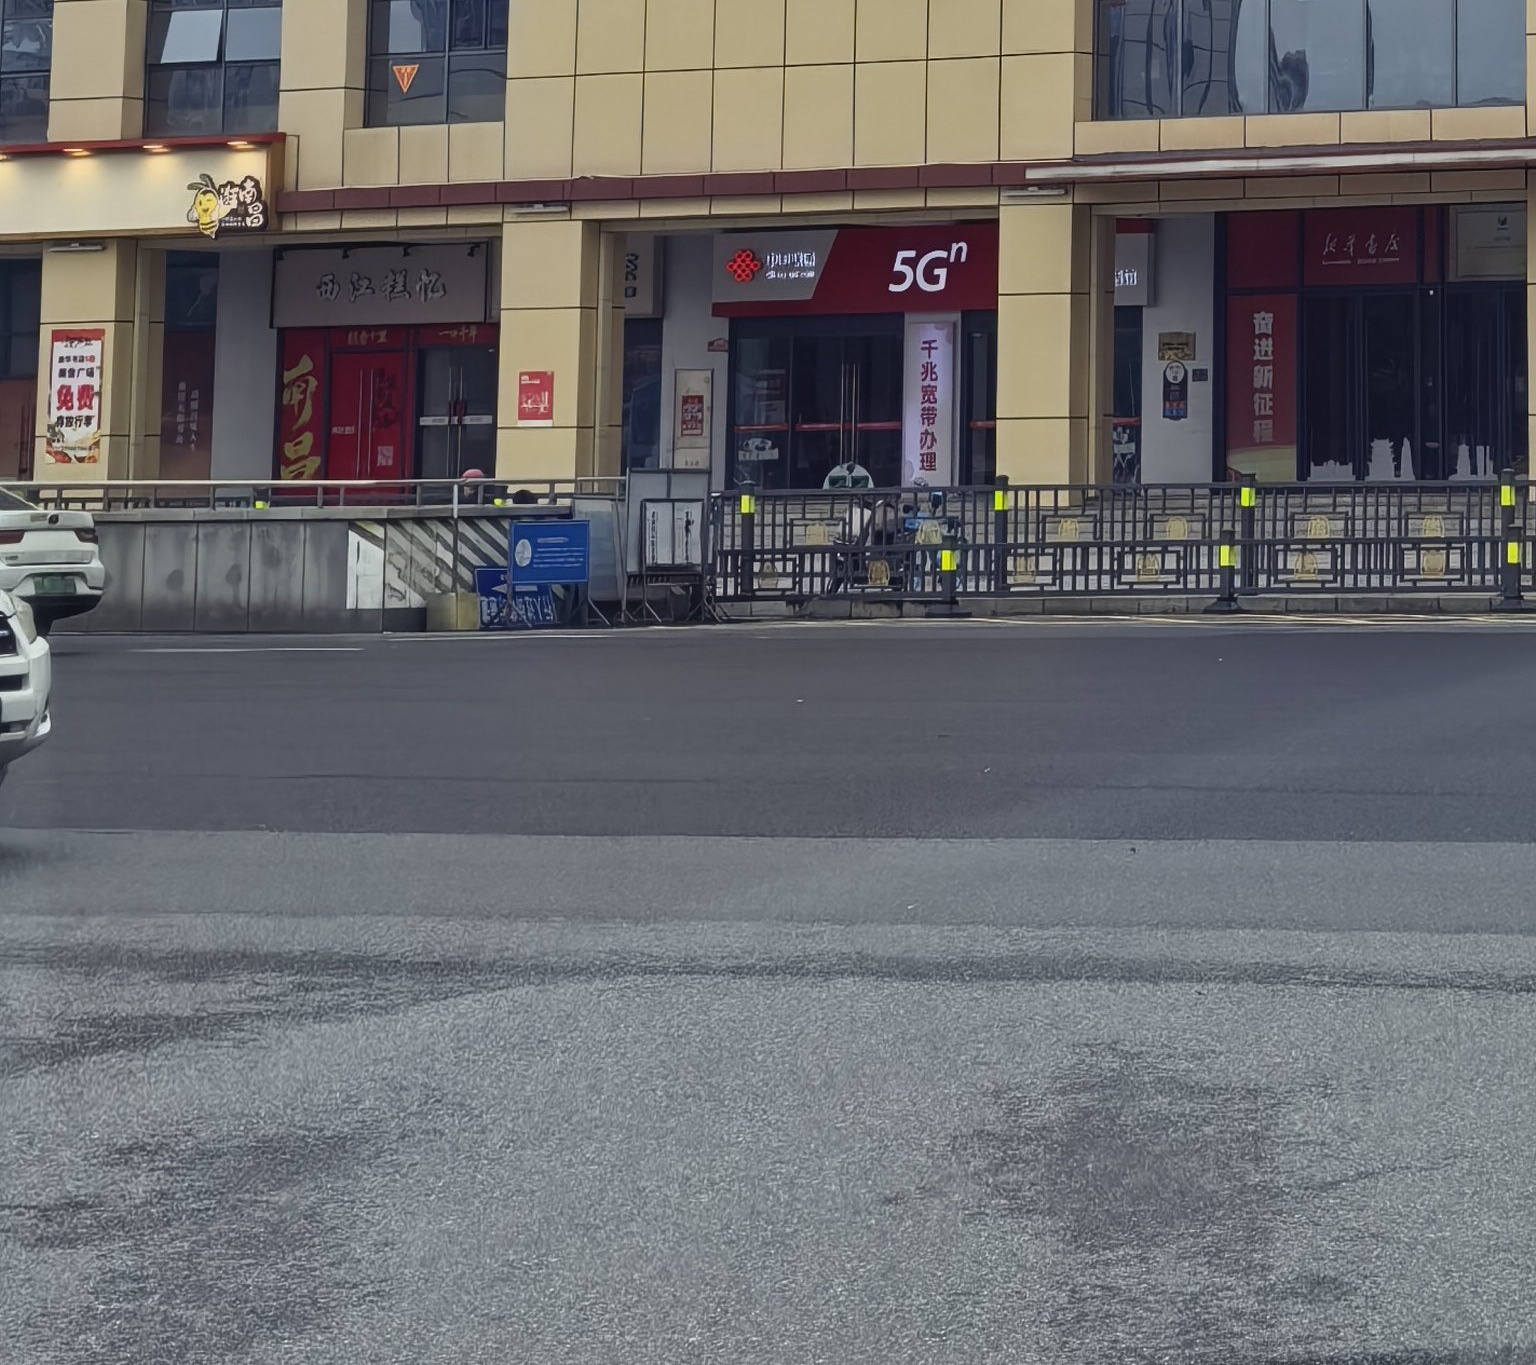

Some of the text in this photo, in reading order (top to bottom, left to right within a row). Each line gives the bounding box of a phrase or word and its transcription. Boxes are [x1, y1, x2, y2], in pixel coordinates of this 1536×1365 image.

[57, 384, 94, 411] 免费
[919, 339, 939, 472] 千兆宽带办理
